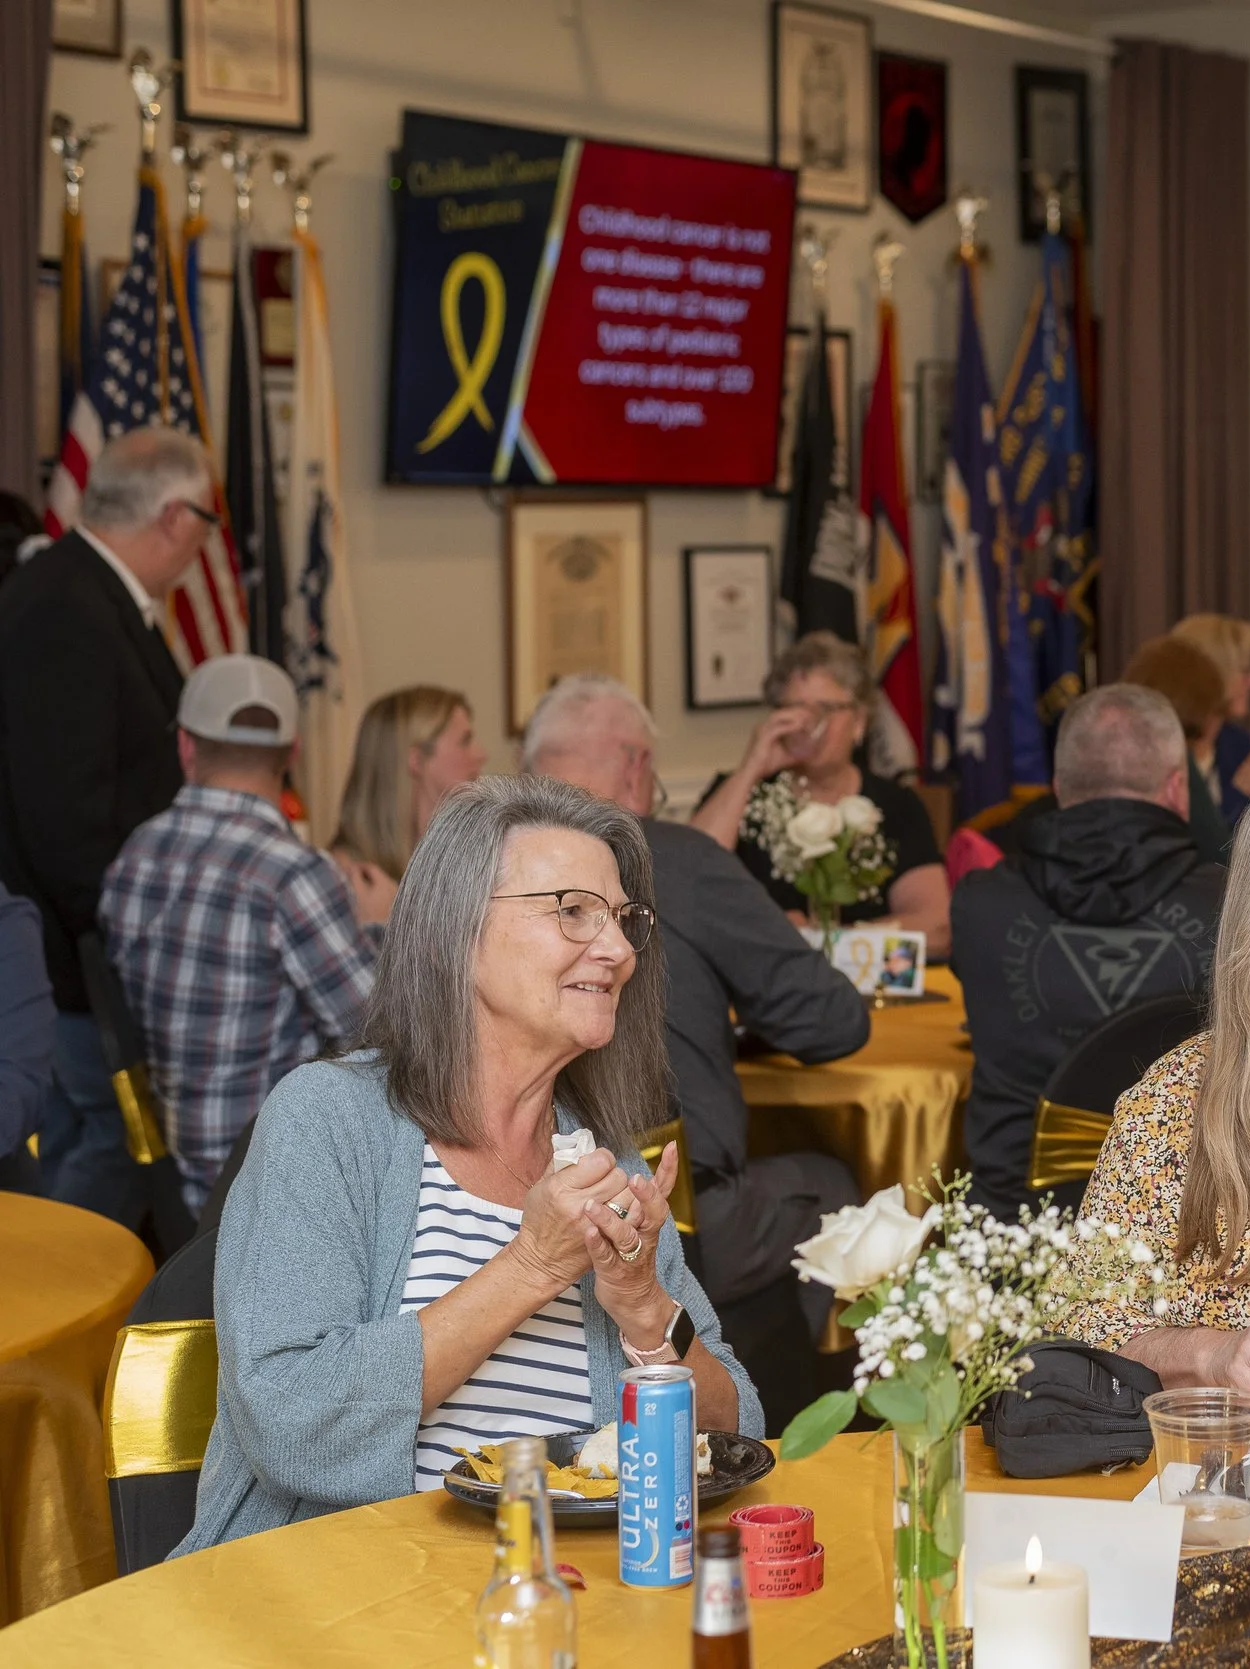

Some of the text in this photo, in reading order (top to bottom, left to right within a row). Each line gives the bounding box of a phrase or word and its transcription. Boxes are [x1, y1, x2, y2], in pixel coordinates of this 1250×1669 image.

[579, 204, 670, 243] Childhood
[670, 219, 722, 249] cancer
[593, 285, 639, 314] more
[640, 286, 679, 316] than
[598, 321, 649, 355] types
[650, 323, 670, 352] of
[648, 362, 683, 389] and
[683, 366, 716, 391] over
[1002, 912, 1038, 1022] OAKLEY
[622, 1436, 641, 1549] ULTRA
[643, 1452, 658, 1531] ZERO
[764, 1544, 801, 1553] OUPON
[769, 1530, 797, 1538] KEEP
[759, 1583, 802, 1591] COUPON
[768, 1568, 796, 1576] KEEP
